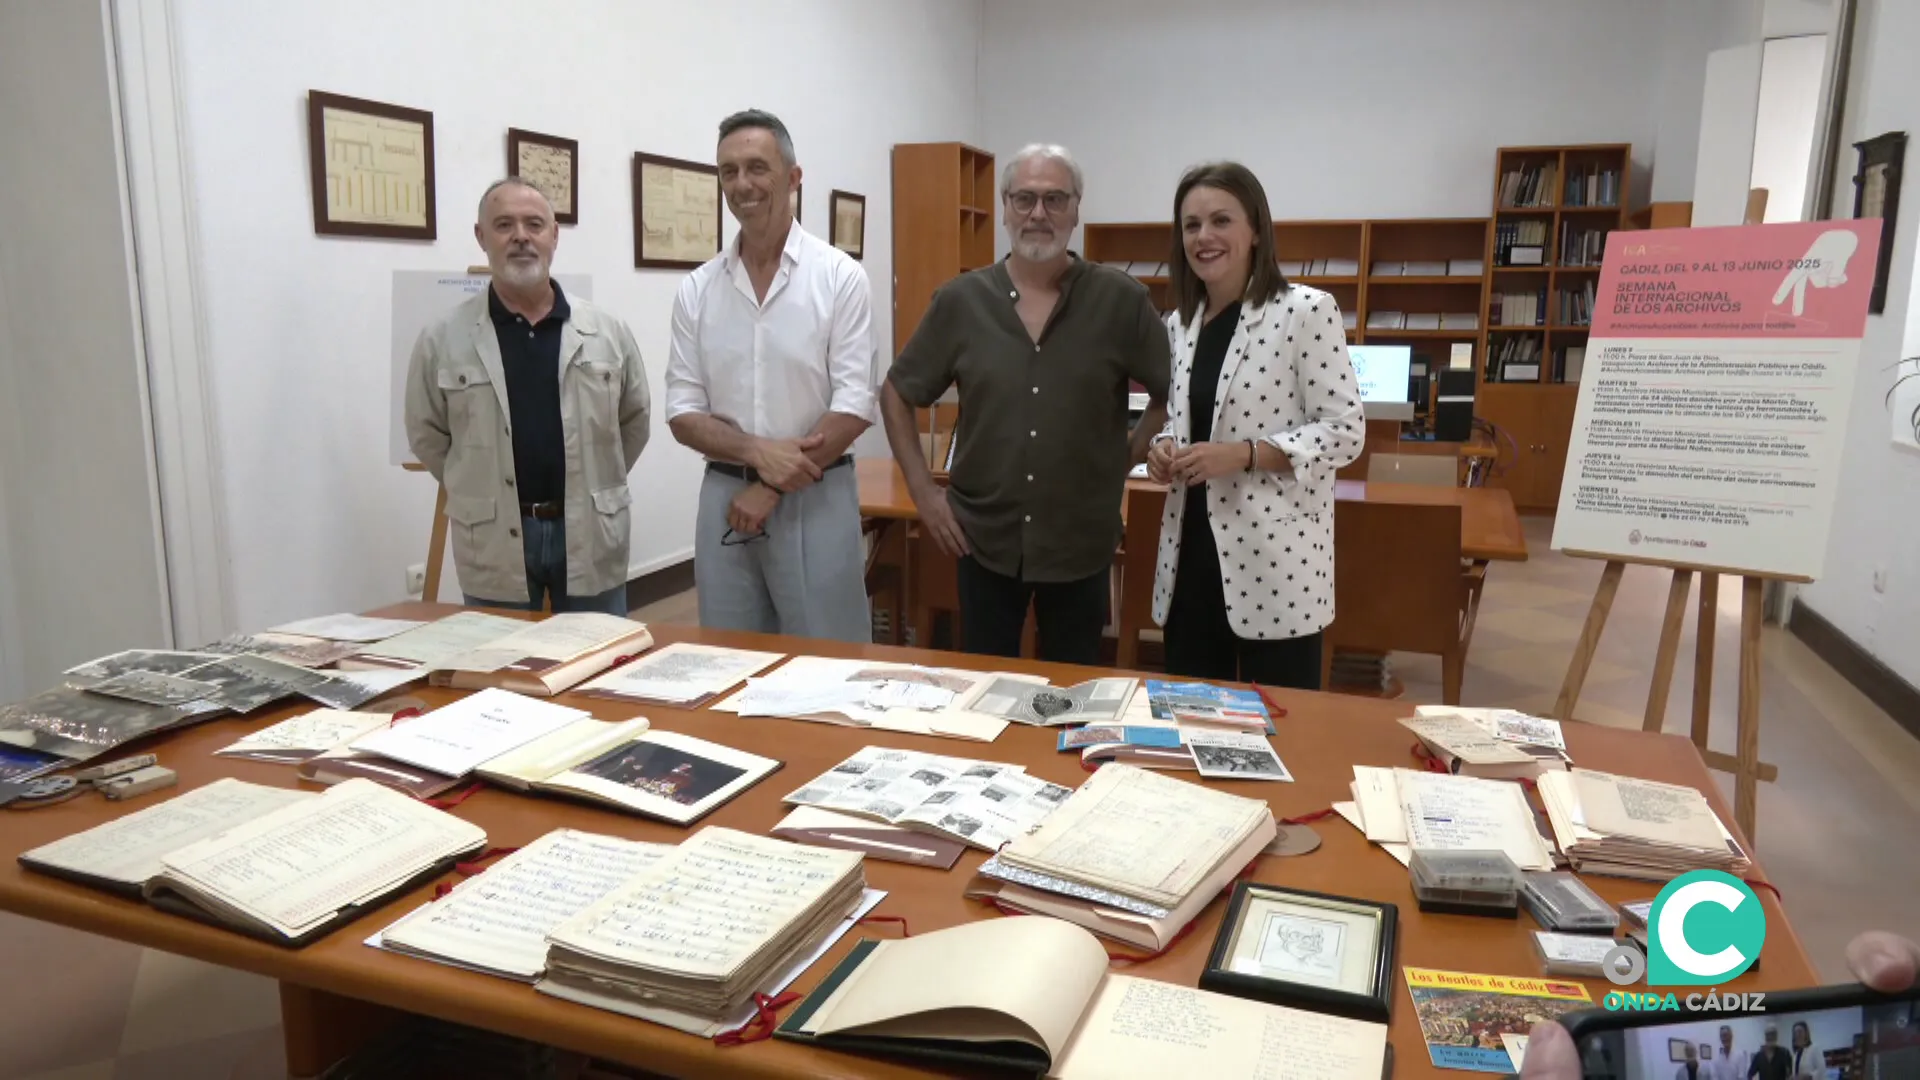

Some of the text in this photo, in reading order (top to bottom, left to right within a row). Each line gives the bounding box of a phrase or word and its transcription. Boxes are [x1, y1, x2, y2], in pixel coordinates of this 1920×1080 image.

[1664, 263, 1686, 273] DEL
[1692, 263, 1699, 271] 9
[1702, 262, 1718, 272] AL
[1722, 261, 1736, 271] 13
[1738, 260, 1783, 270] JUNIO
[1787, 258, 1821, 270] 2025
[1616, 281, 1676, 292] SEMANA
[1615, 292, 1729, 303] INTERNACIONAL
[1613, 302, 1741, 314] DE LOS ARCHIVOS
[1411, 972, 1432, 982] Los
[1437, 974, 1484, 987] Beatles
[1489, 977, 1504, 988] de
[1509, 979, 1546, 992] Cádiz
